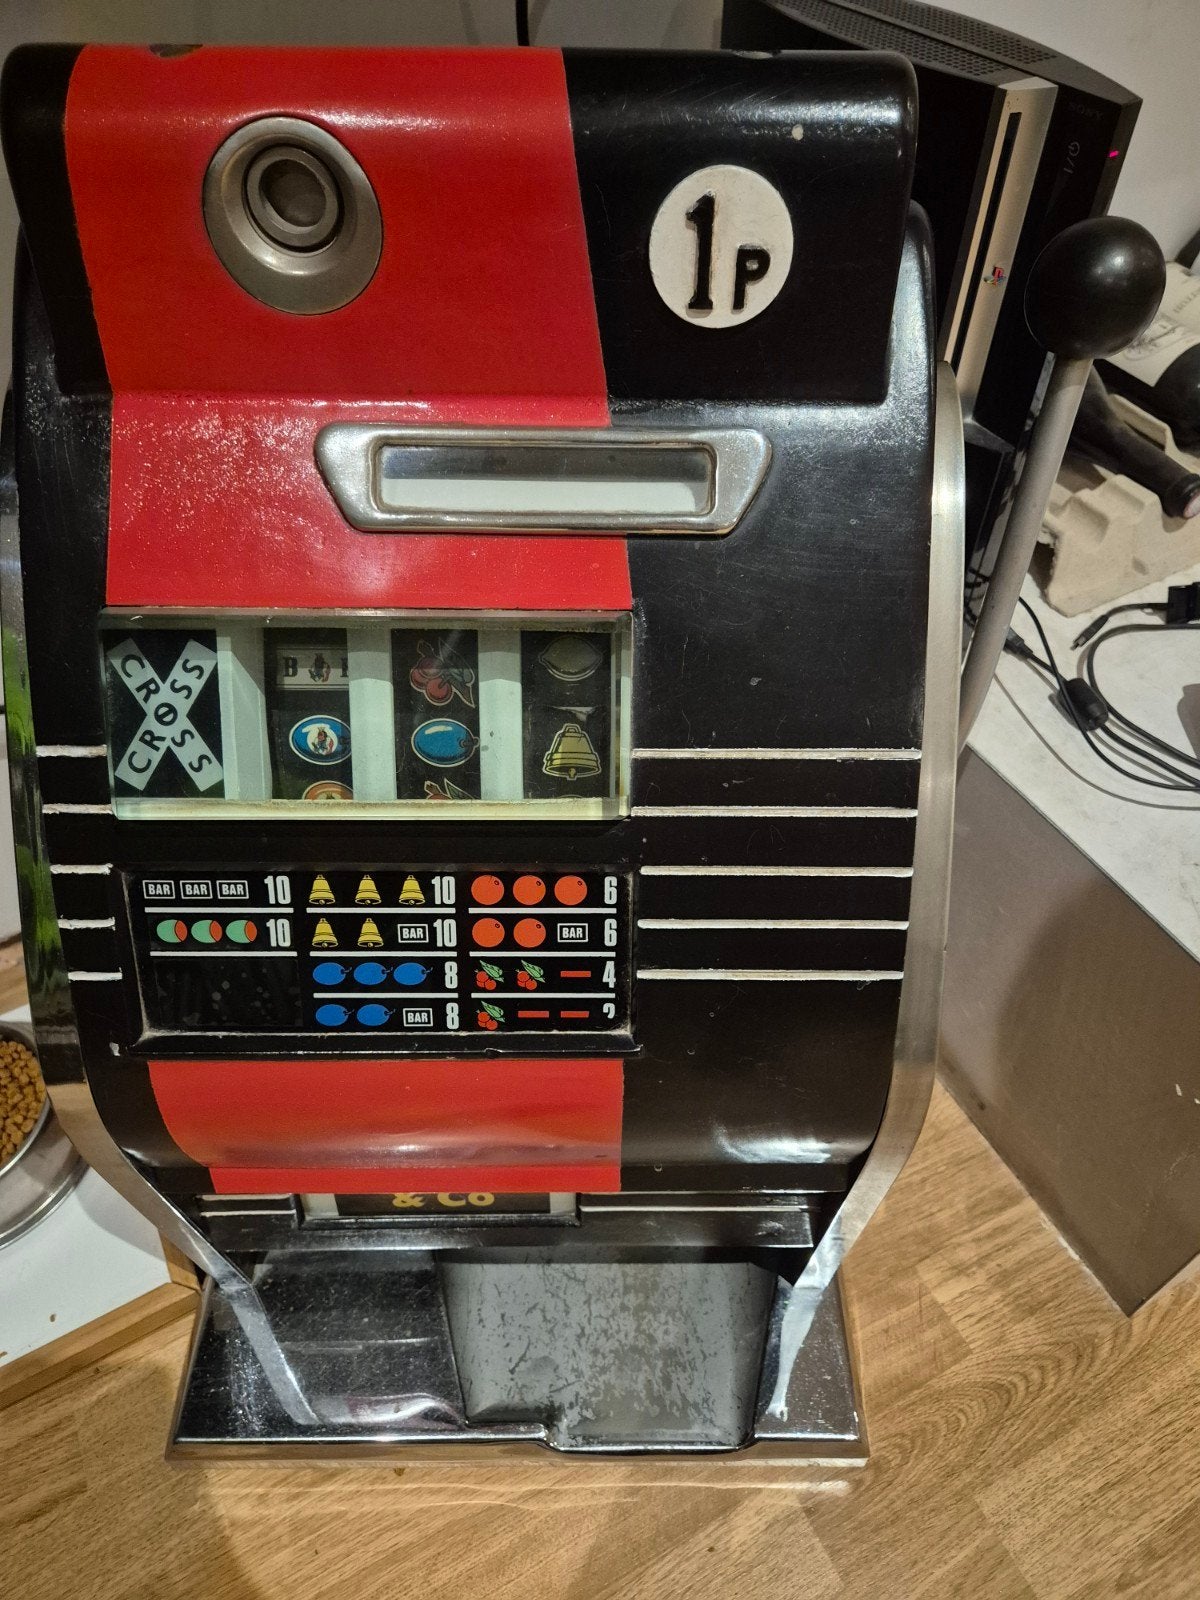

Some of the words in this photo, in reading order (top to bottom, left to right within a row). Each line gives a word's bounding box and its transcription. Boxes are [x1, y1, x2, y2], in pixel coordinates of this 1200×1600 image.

[121, 654, 212, 773] CROSS
[128, 659, 204, 773] CROSS
[148, 884, 171, 895] BAR
[185, 884, 208, 895] BAR
[221, 884, 244, 895] BAR
[264, 875, 291, 904] 10
[431, 875, 456, 905] 10
[604, 875, 617, 905] 6
[266, 918, 291, 947] 10
[402, 928, 424, 939] BAR
[433, 918, 458, 947] 10
[562, 927, 583, 938] BAR
[604, 918, 617, 947] 6
[444, 961, 459, 989] 8
[602, 960, 617, 988] 4
[407, 1012, 428, 1023] BAR
[445, 1002, 460, 1030] 8
[392, 1192, 425, 1208] &
